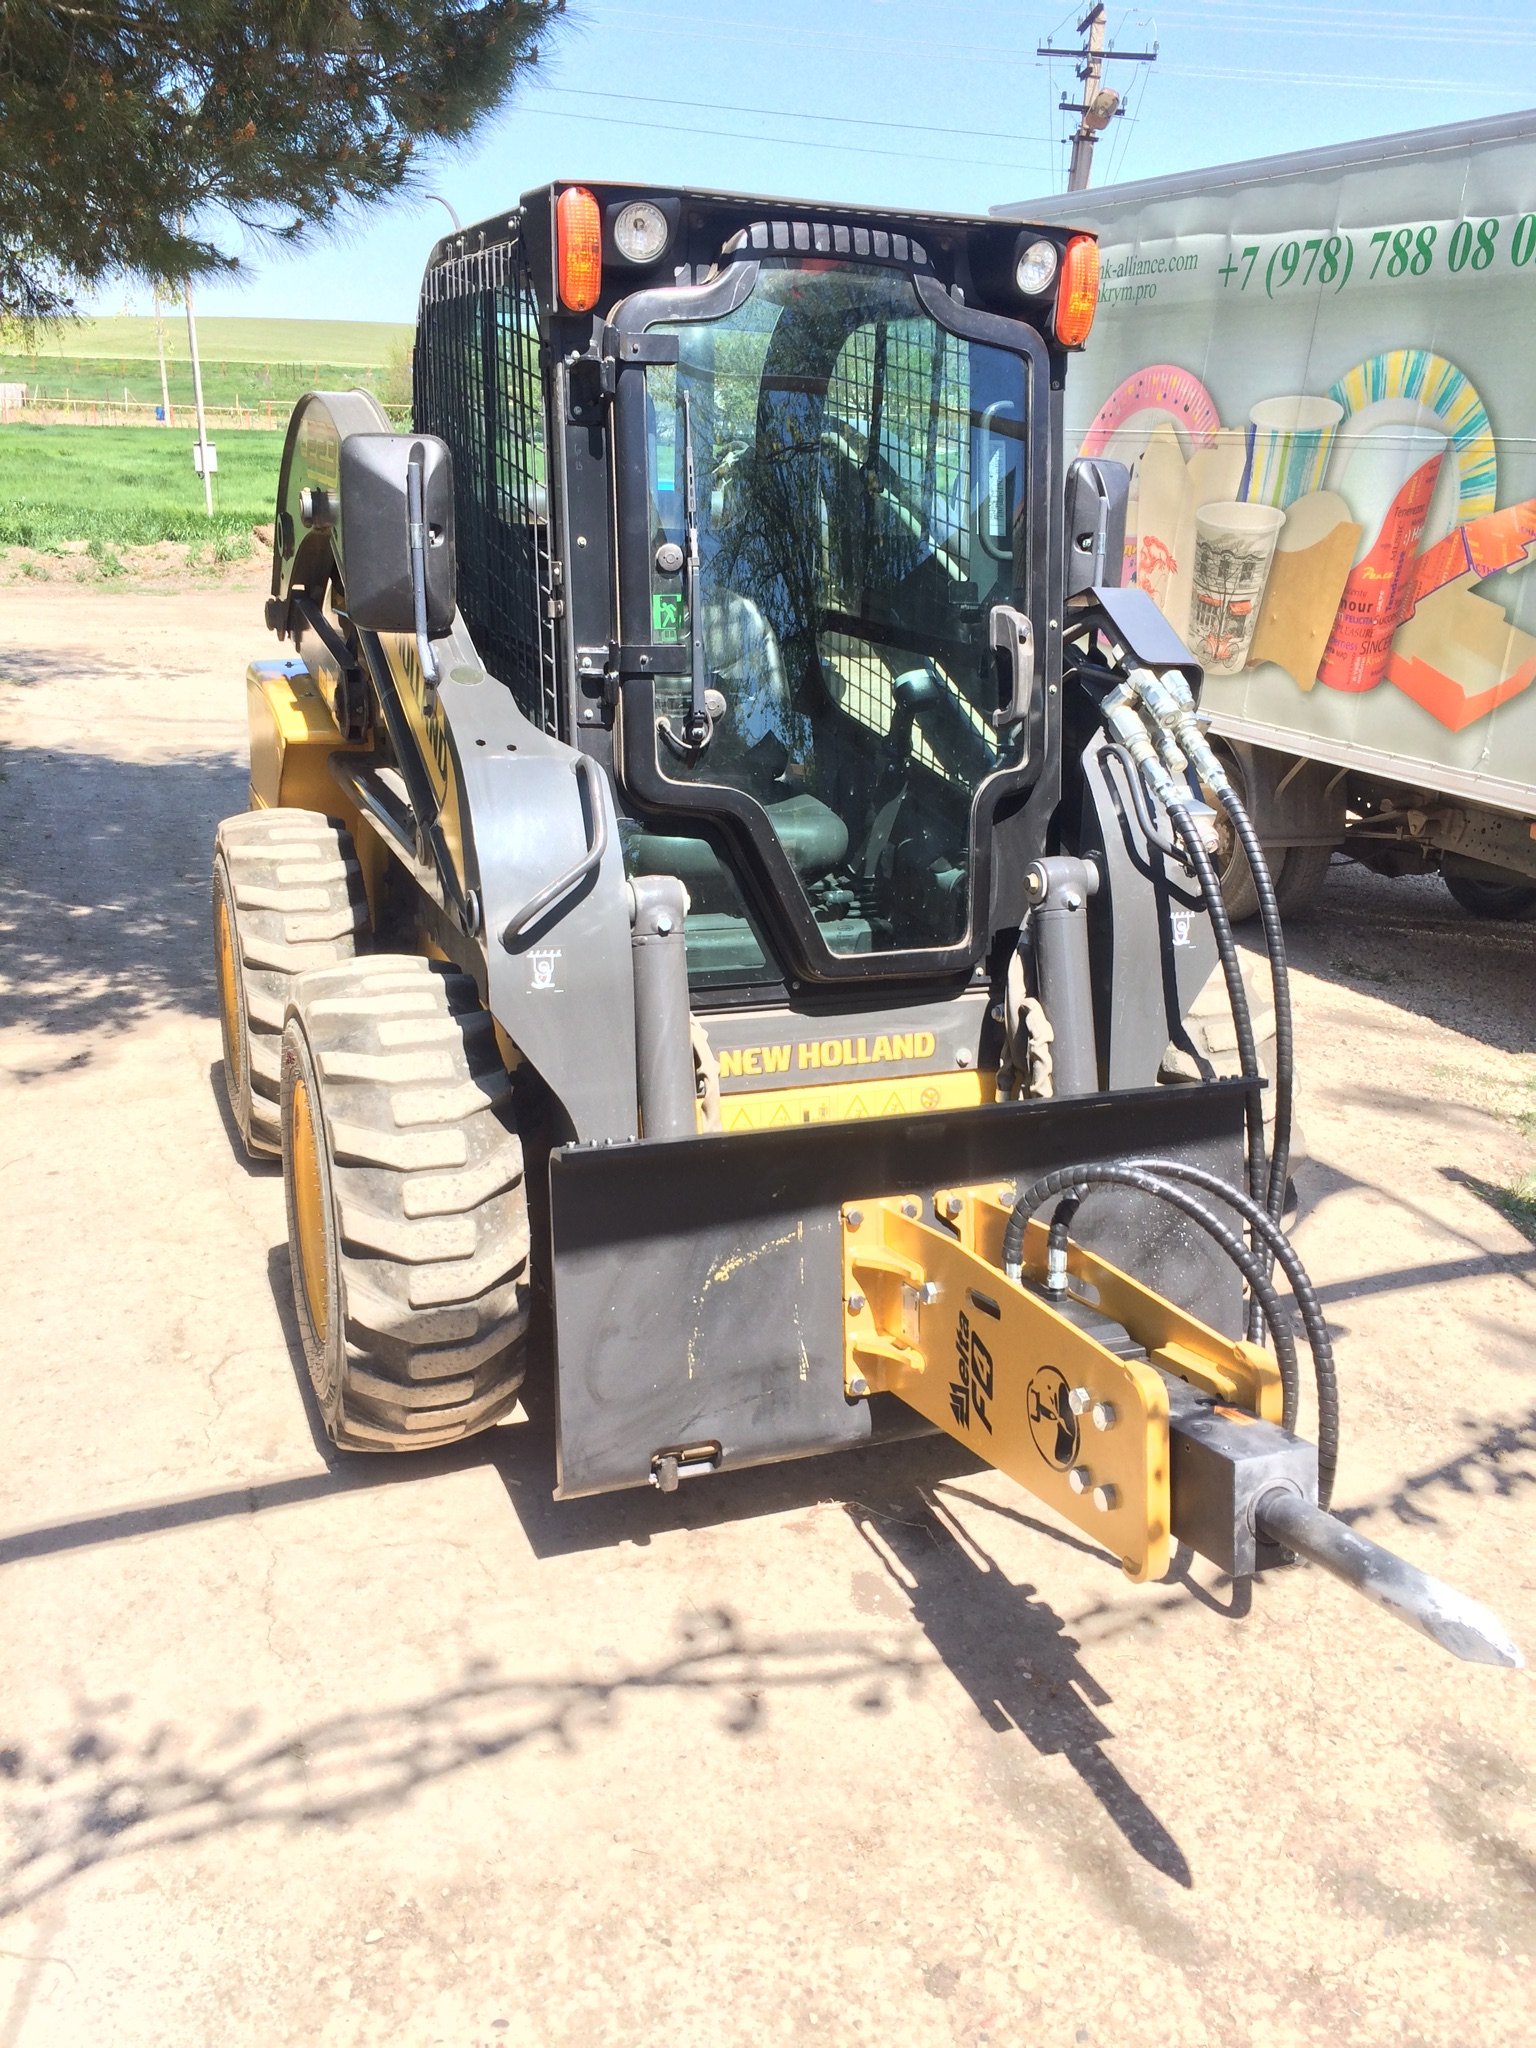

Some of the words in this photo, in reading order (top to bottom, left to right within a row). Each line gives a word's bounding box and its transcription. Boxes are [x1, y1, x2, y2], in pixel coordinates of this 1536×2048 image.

[1218, 246, 1260, 291] +7
[1265, 235, 1354, 299] (978)
[1369, 225, 1437, 280] 788
[1449, 218, 1500, 272] 08
[1511, 213, 1536, 267] 0
[719, 1044, 792, 1078] NEW
[798, 1031, 936, 1070] HOLLAND
